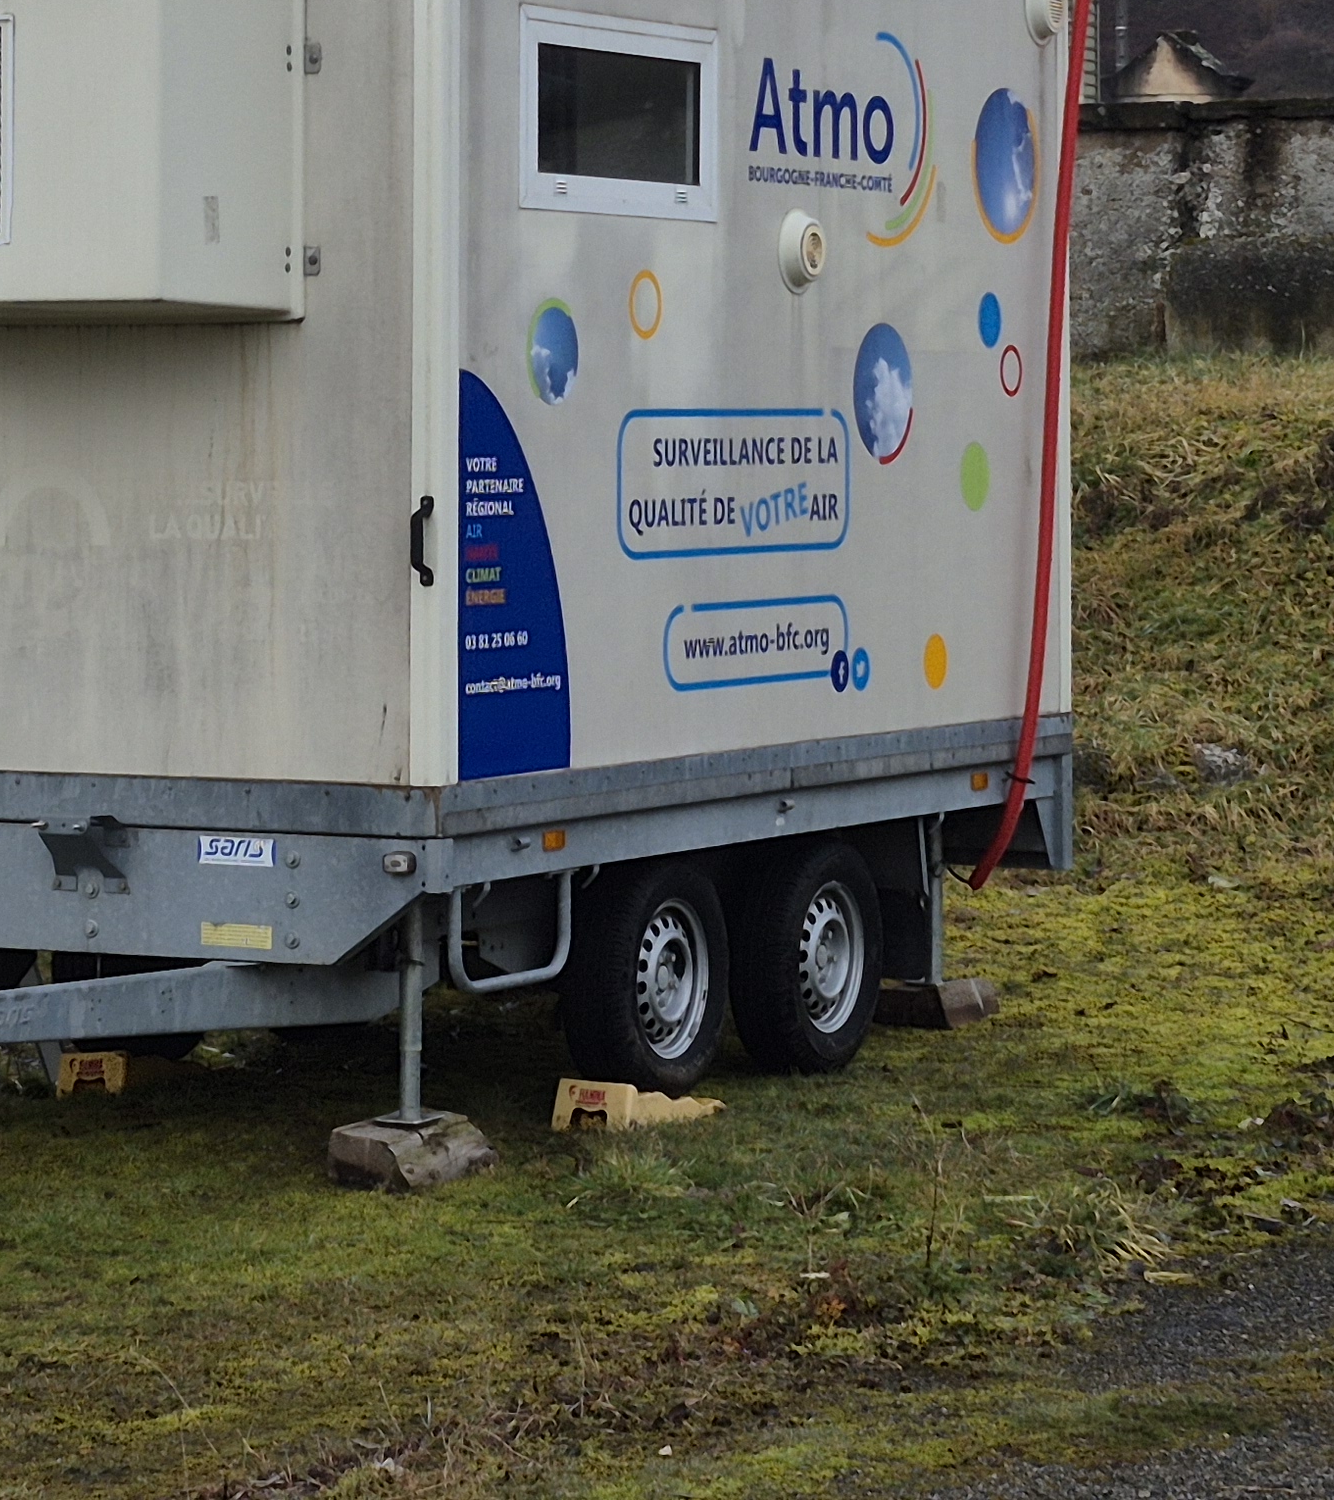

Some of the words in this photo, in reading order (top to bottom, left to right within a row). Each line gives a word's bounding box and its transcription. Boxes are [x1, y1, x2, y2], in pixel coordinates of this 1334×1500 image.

[749, 57, 894, 165] Atmo
[748, 165, 893, 193] BOURGOGNE-FRANCHE-COMTÉ
[653, 437, 785, 467] SURVEILLANCE
[791, 437, 812, 464] DE
[818, 436, 838, 464] LA
[466, 457, 497, 472] VOTRE
[466, 478, 524, 494] PARTENAIRE
[466, 498, 514, 516] RÉGIONAL
[628, 489, 708, 536] QUALITÉ
[714, 497, 736, 525] DE
[740, 482, 809, 537] VOTRE
[810, 494, 839, 521] AIR
[466, 524, 483, 538] AIR
[466, 567, 502, 583] CLIMAT
[465, 634, 476, 650] 03
[478, 634, 489, 649] 81
[491, 632, 502, 649] 25
[504, 631, 515, 647] 06
[517, 630, 528, 646] 60
[683, 622, 830, 660] www.atmo-bfc.org
